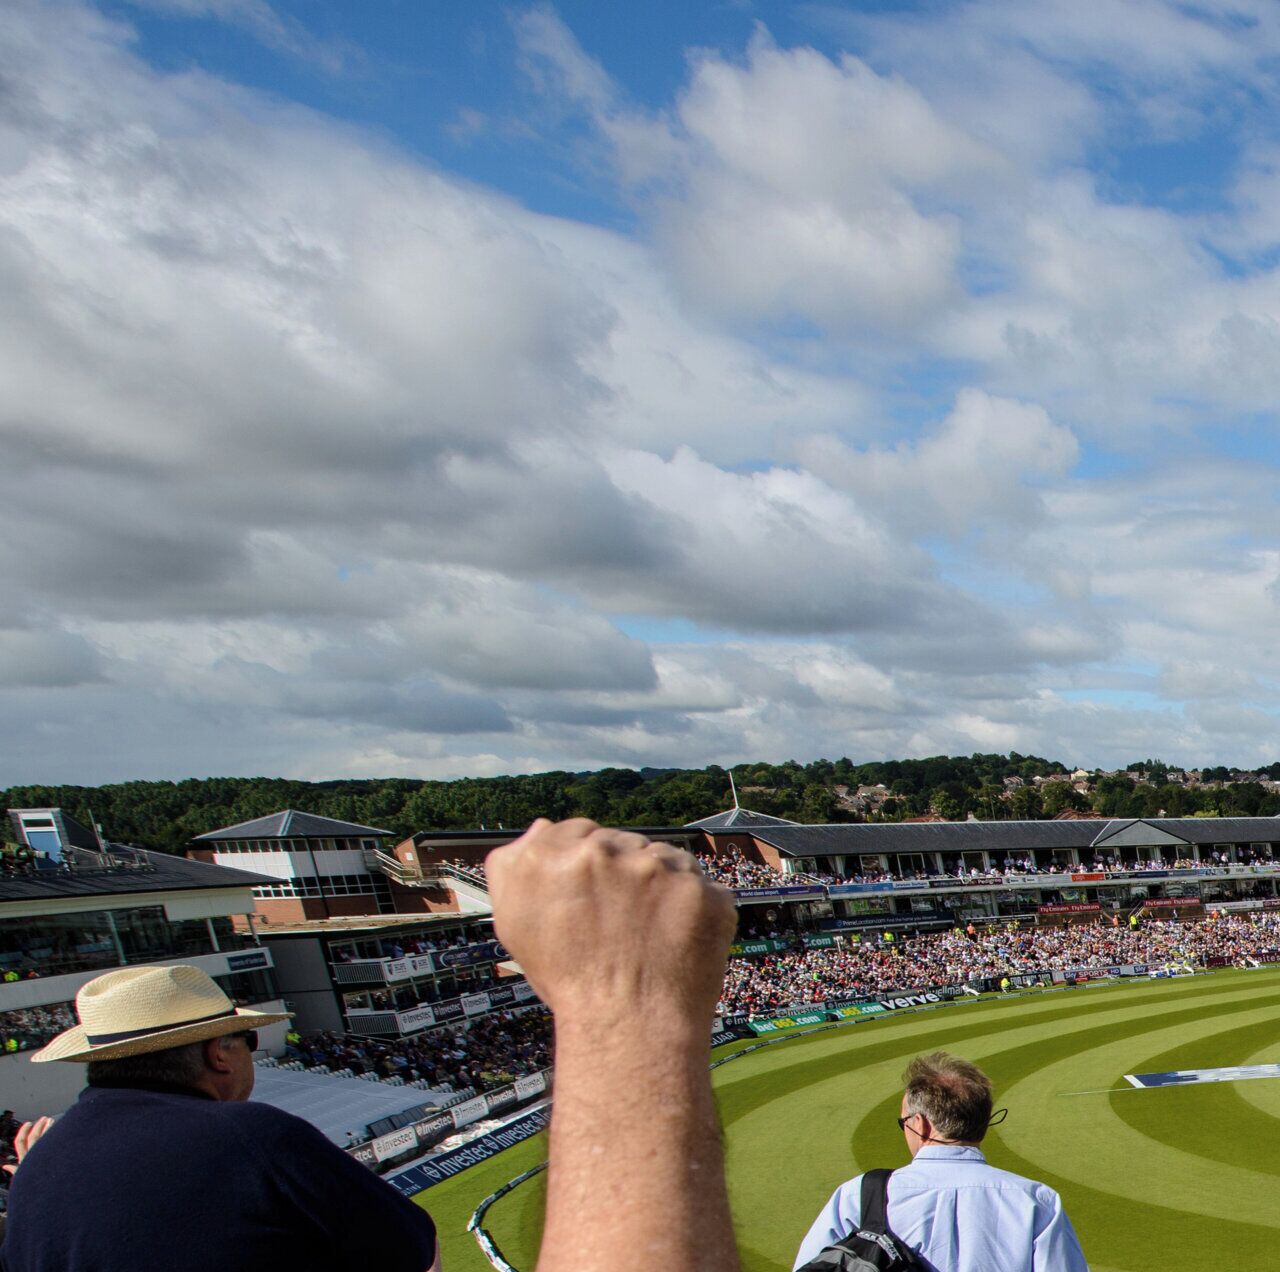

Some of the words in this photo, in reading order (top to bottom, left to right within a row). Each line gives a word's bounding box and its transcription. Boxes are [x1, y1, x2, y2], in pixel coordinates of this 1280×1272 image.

[728, 942, 768, 955] 65.com
[1078, 968, 1109, 977] SPORTS
[467, 997, 488, 1010] Investec
[493, 991, 514, 1003] Investec
[833, 998, 868, 1009] Investec
[880, 993, 940, 1010] verve
[438, 1002, 462, 1016] Investec
[785, 1005, 822, 1017] Investec
[835, 1002, 883, 1018] t365.com
[405, 1013, 432, 1024] Investec
[753, 1014, 820, 1032] bet365.com
[521, 1076, 544, 1091] Investec
[491, 1088, 515, 1106] Investec
[460, 1100, 485, 1118] Investec
[421, 1113, 452, 1137] Investec
[383, 1130, 415, 1153] Investec
[494, 1118, 535, 1150] Investec
[438, 1142, 492, 1176] Investec
